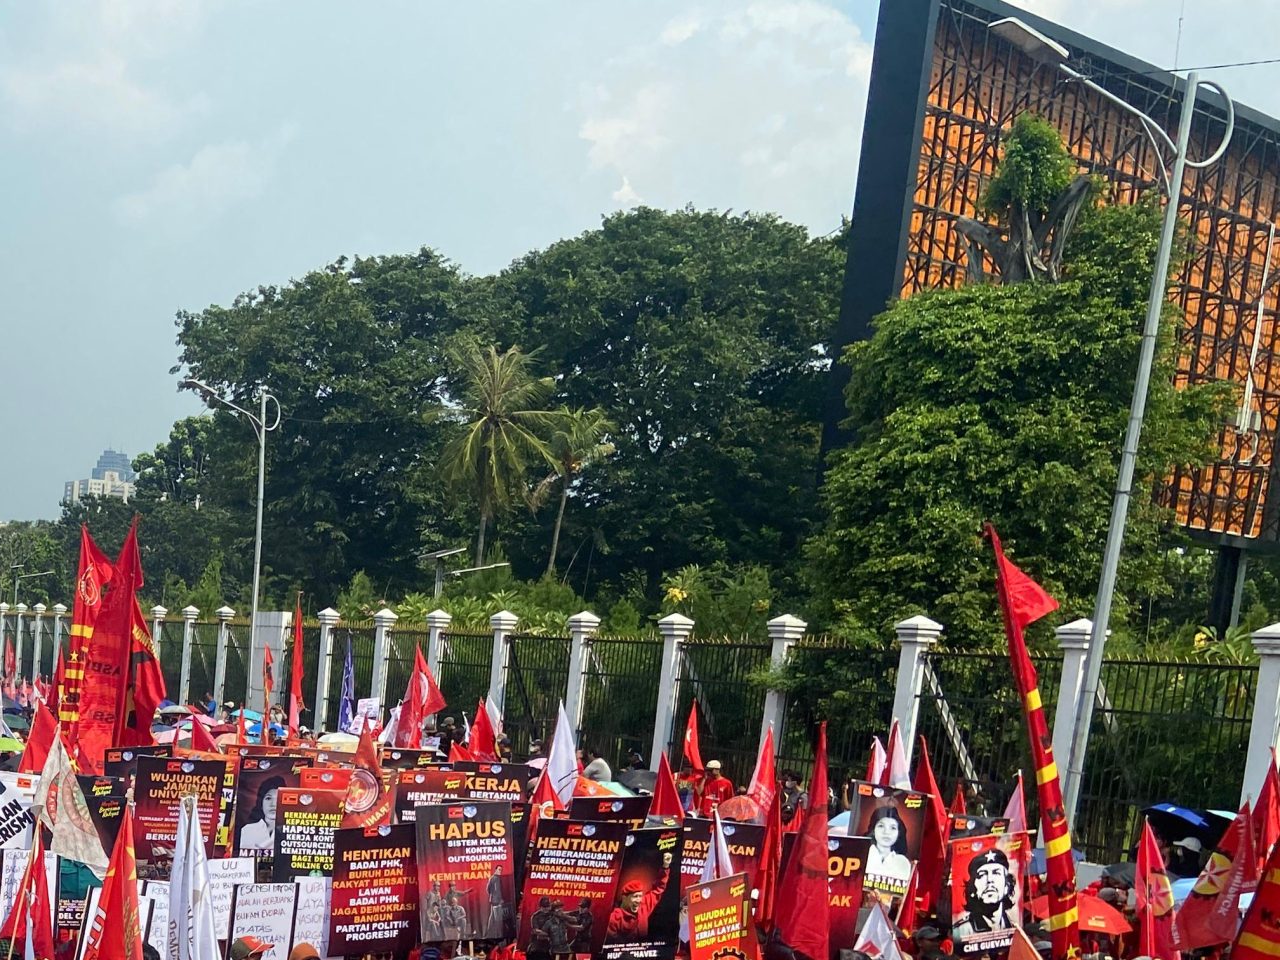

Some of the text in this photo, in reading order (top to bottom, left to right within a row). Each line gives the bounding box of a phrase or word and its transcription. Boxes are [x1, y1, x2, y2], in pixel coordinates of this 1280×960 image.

[151, 773, 218, 785] WUJUDKAN
[464, 777, 521, 792] KERJA
[470, 790, 521, 800] BERTAHUN
[284, 811, 318, 820] BERIKAN
[285, 819, 329, 828] KEPASTIAN
[282, 825, 316, 835] HAPUS
[429, 820, 506, 841] HAPUS
[286, 834, 311, 842] KERJA
[447, 838, 507, 848] SISTEM KERJA
[465, 846, 507, 855] KONTRAK,
[537, 837, 620, 853] HENTIKAN
[281, 847, 328, 856] KEMITRAAN
[343, 847, 411, 862] HENTIKAN
[538, 850, 614, 861] PEMBERANGUSAN
[291, 855, 313, 863] BAGI
[447, 853, 508, 863] OUTSOURCING
[539, 857, 610, 869] SERIKAT BURUH,
[349, 859, 403, 870] BADAI PHK,
[470, 862, 492, 871] DAN
[348, 869, 404, 880] BURUH DAN
[428, 870, 492, 882] KEMITRAAN
[531, 865, 616, 876] TINDAKAN REPRESIF
[332, 877, 418, 890] RAKYAT BERSATU,
[530, 872, 612, 884] DAN KRIMINALISASI
[552, 881, 587, 890] AKTIVIS
[358, 887, 391, 896] LAWAN
[531, 887, 607, 899] GERAKAN RAKYAT
[349, 895, 400, 907] BADAI PHK
[332, 903, 416, 917] JAGA DEMOKRASI
[694, 905, 737, 923] WUJUDKAN
[353, 913, 393, 924] BANGUN
[716, 917, 737, 929] LAYAK
[335, 920, 410, 934] PARTAI POLITIK
[695, 923, 741, 940] KERJA LAYAK
[345, 930, 399, 942] PROGRESIF
[716, 932, 740, 944] LAYAK
[963, 942, 979, 953] CHE
